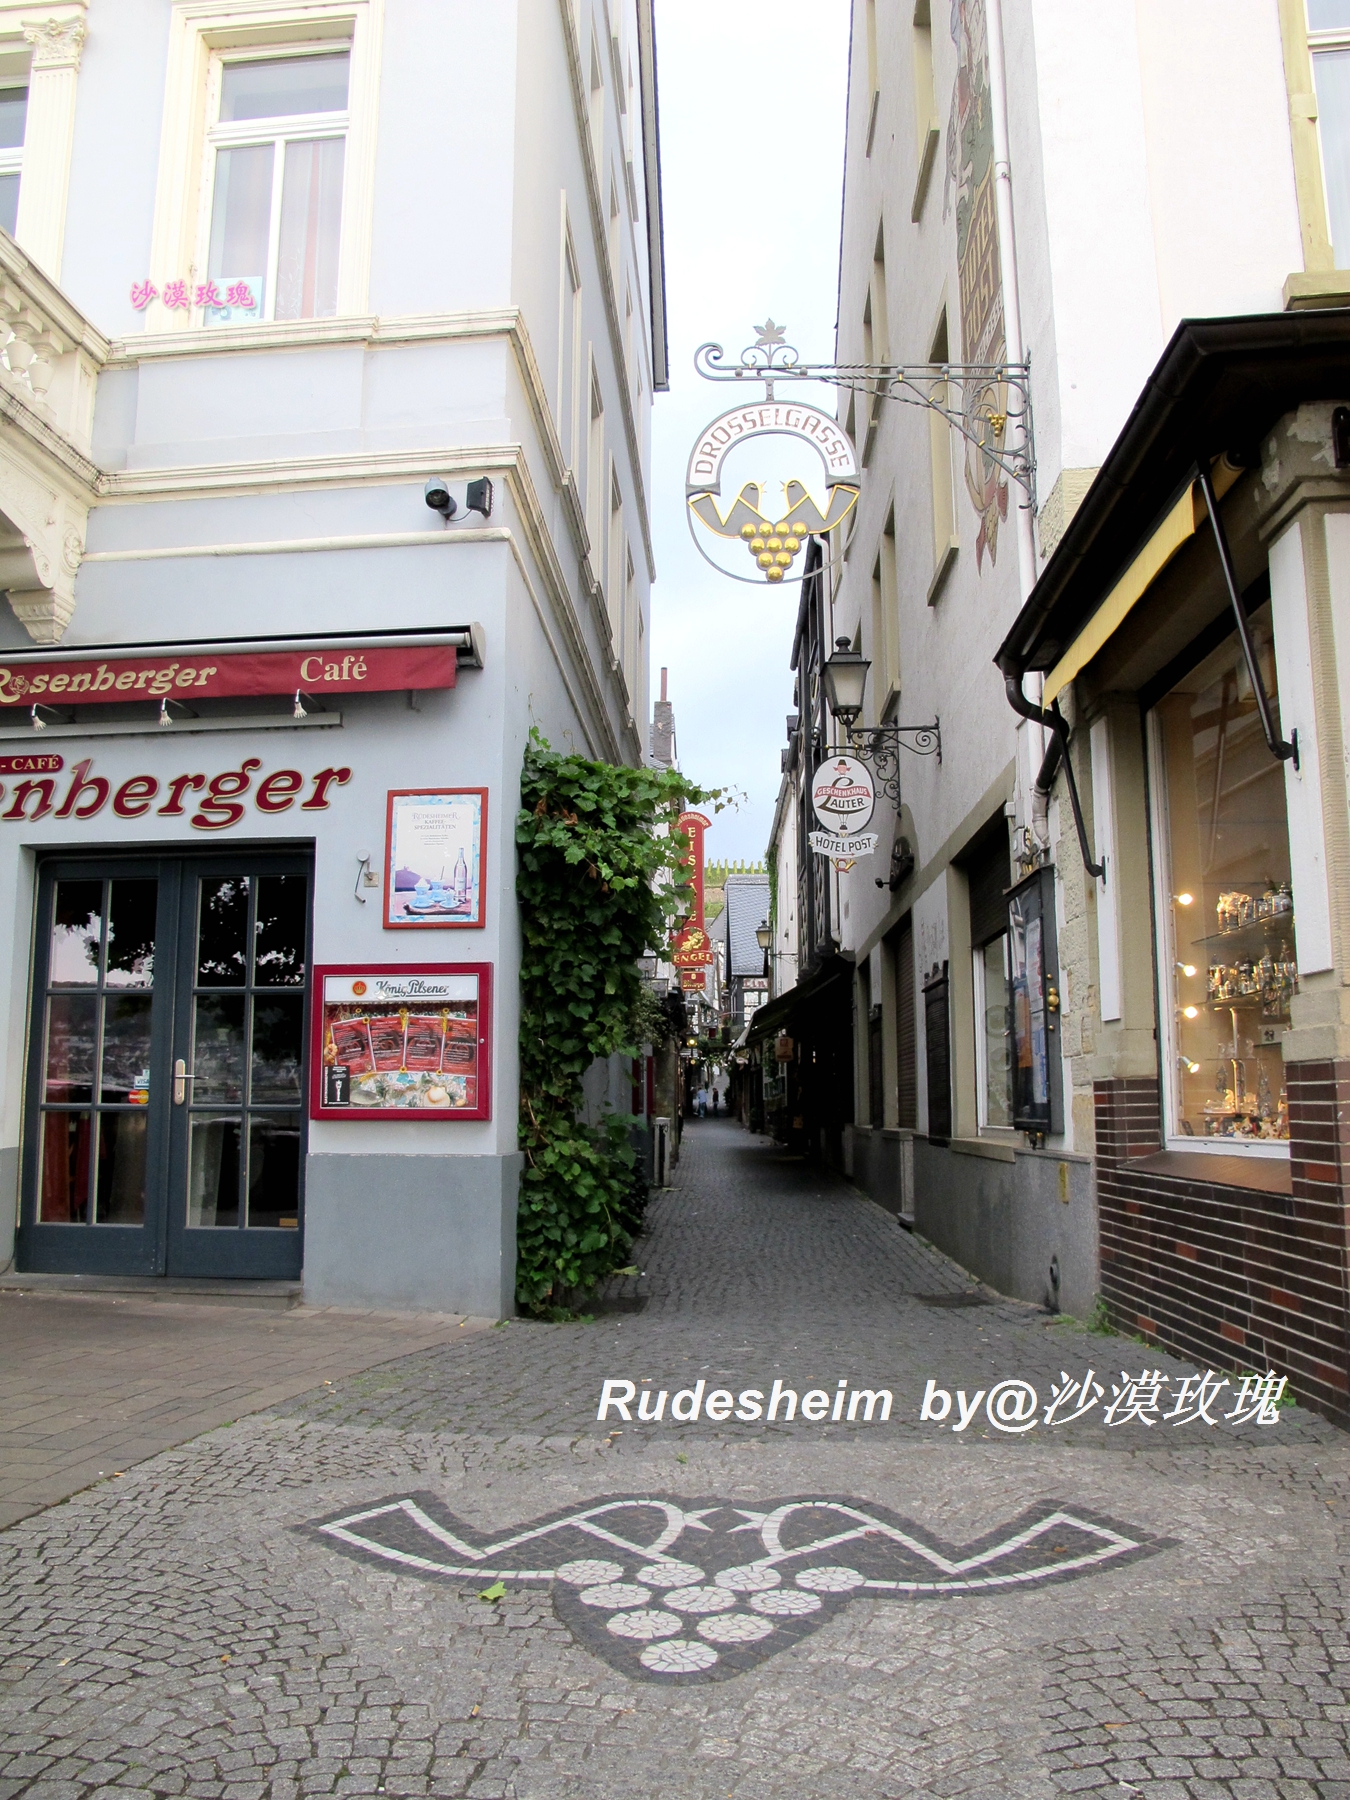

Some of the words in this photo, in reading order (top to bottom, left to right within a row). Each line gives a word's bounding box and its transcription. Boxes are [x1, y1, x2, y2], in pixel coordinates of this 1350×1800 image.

[961, 182, 994, 318] HOTEL
[966, 242, 994, 363] POST
[694, 408, 851, 476] DROSSELGASSE
[300, 655, 368, 683] Café
[11, 755, 60, 770] CAFÉ
[0, 757, 353, 830] nberger
[817, 787, 868, 798] GESCHENKHAUS
[816, 836, 846, 853] HOTEL
[848, 837, 872, 852] POST
[673, 952, 713, 964] ENGEL
[376, 980, 408, 997] König
[407, 979, 450, 997] Pilsener
